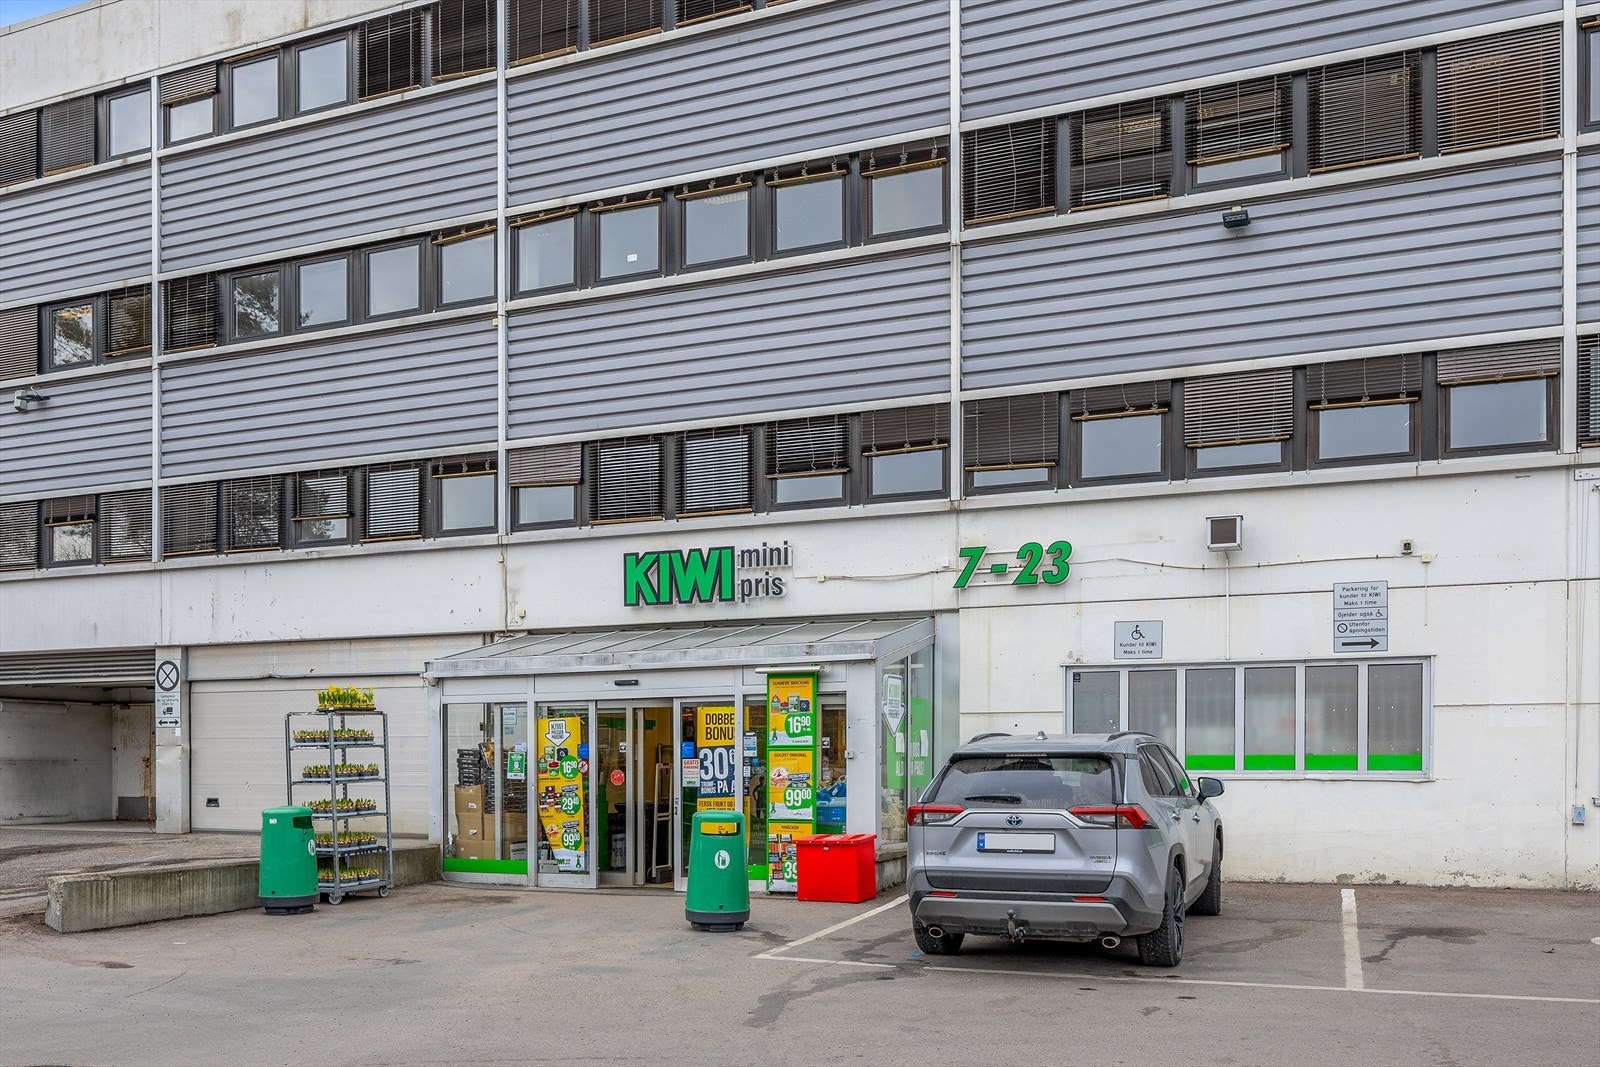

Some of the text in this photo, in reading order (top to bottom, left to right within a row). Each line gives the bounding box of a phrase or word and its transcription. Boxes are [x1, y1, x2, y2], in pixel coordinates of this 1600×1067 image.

[740, 540, 790, 568] mini
[623, 546, 735, 607] KIWI
[740, 571, 785, 603] pris
[705, 713, 735, 726] DOBBE
[705, 726, 735, 741] BONU
[717, 780, 729, 794] PÅ
